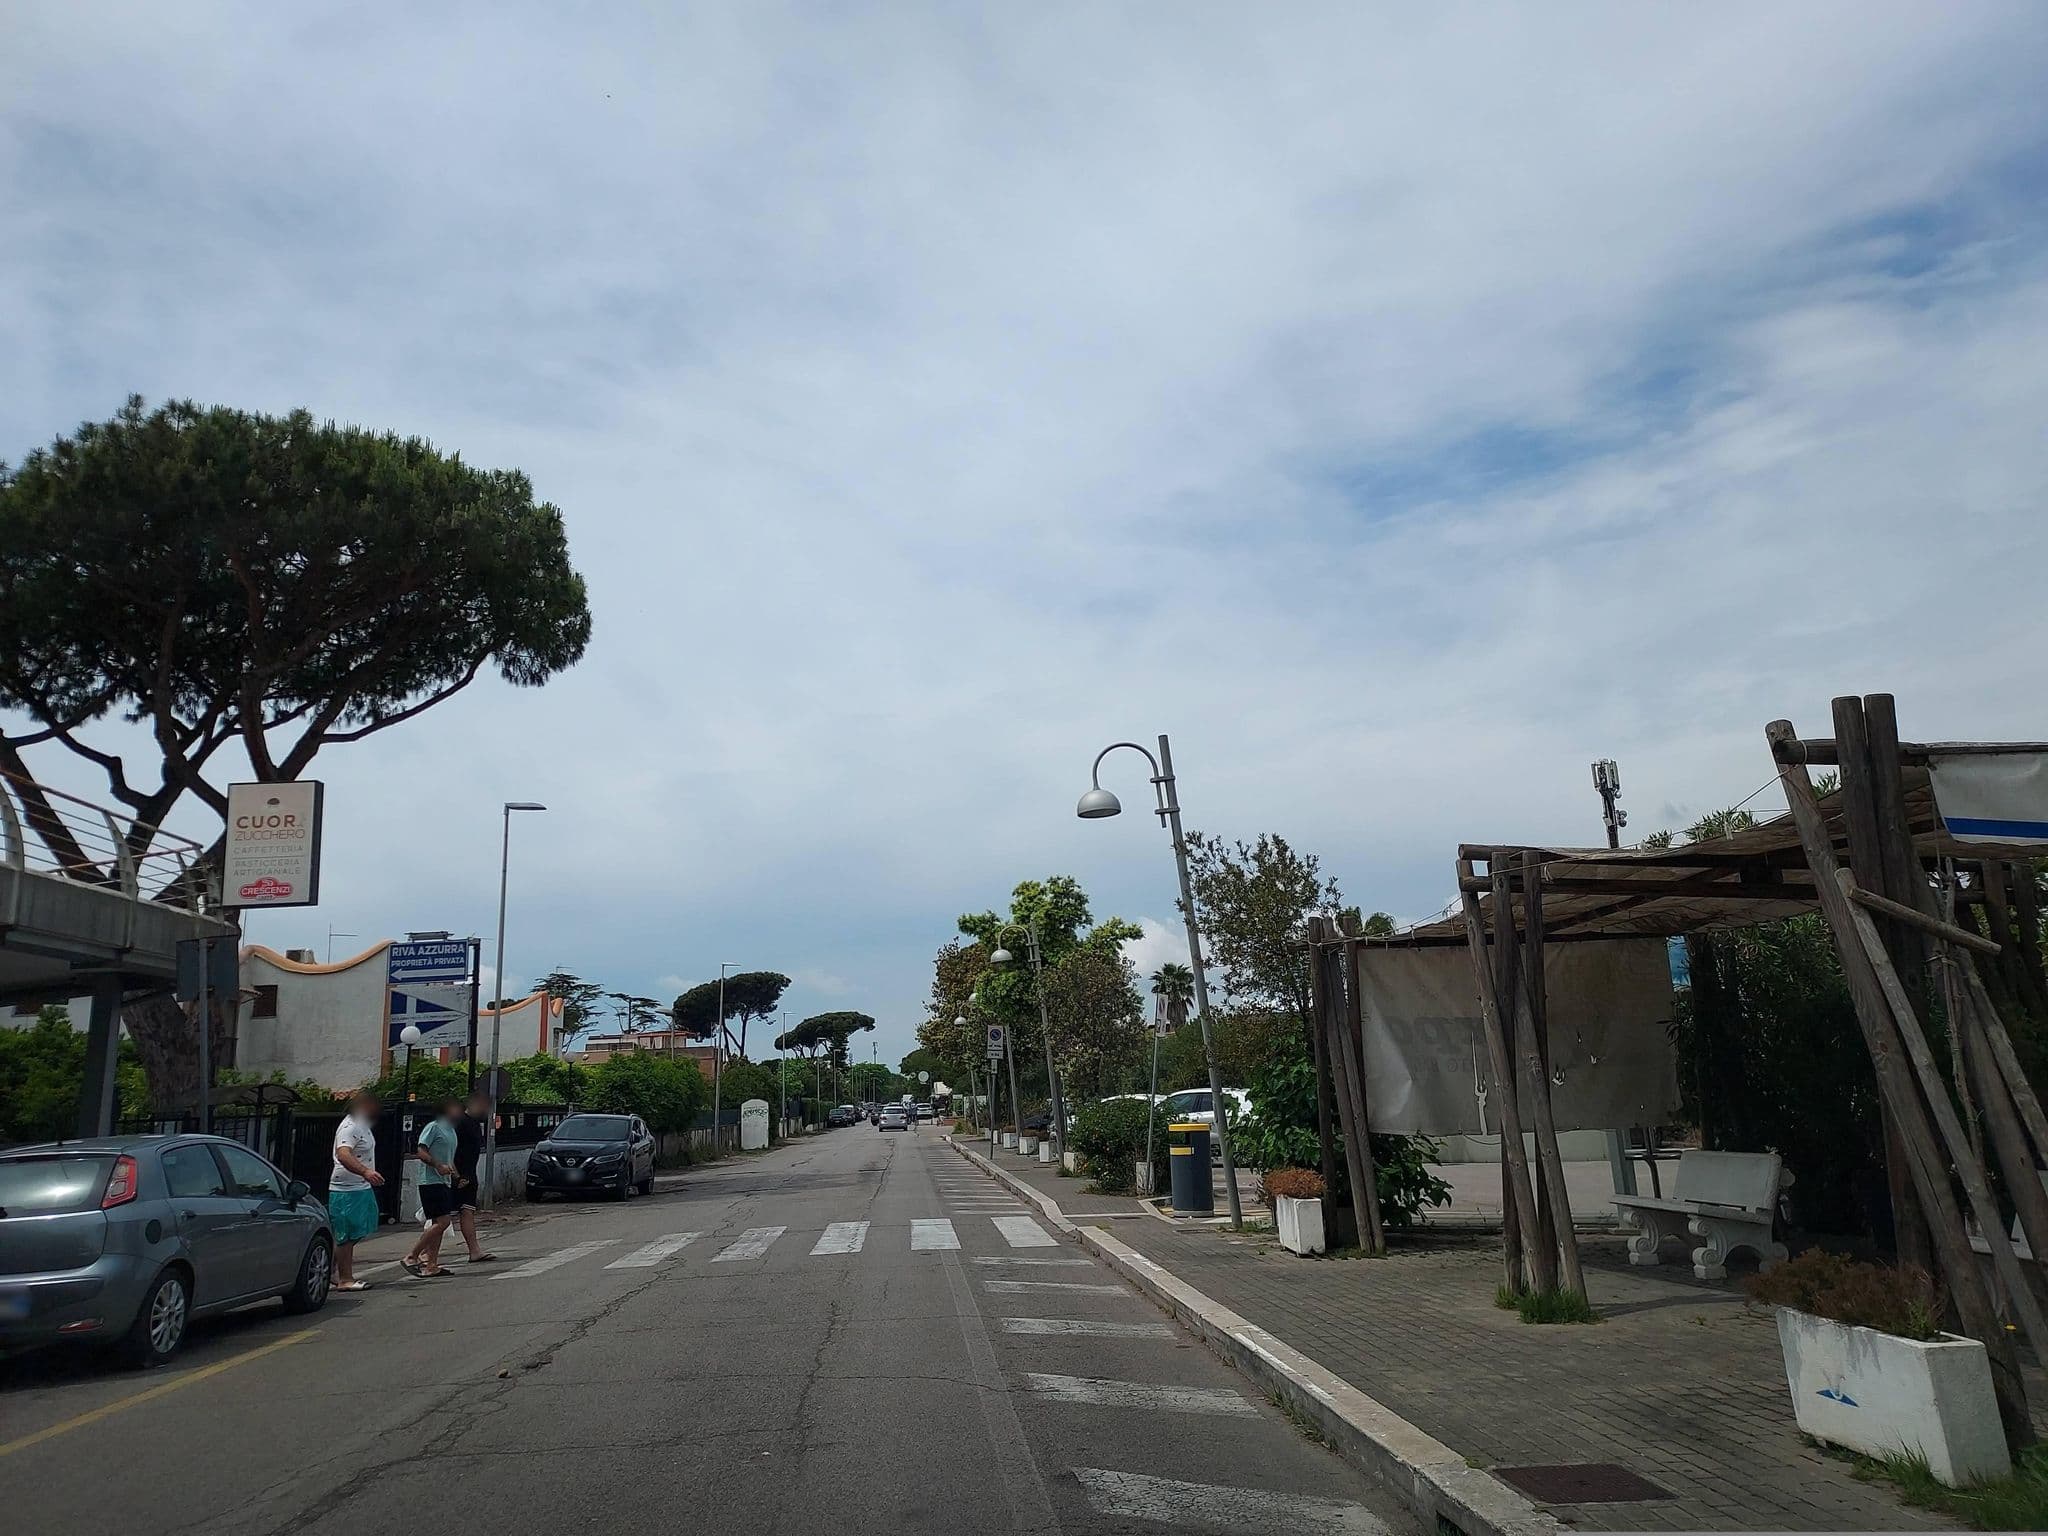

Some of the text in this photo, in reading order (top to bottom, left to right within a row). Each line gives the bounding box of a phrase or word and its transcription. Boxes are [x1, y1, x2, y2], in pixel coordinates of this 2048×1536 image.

[236, 815, 295, 828] CUOR
[234, 828, 305, 841] ZUCCHERO
[391, 944, 464, 957] RIVA AZZURRA
[391, 956, 465, 968] PROPRIETÀ PRIVATA
